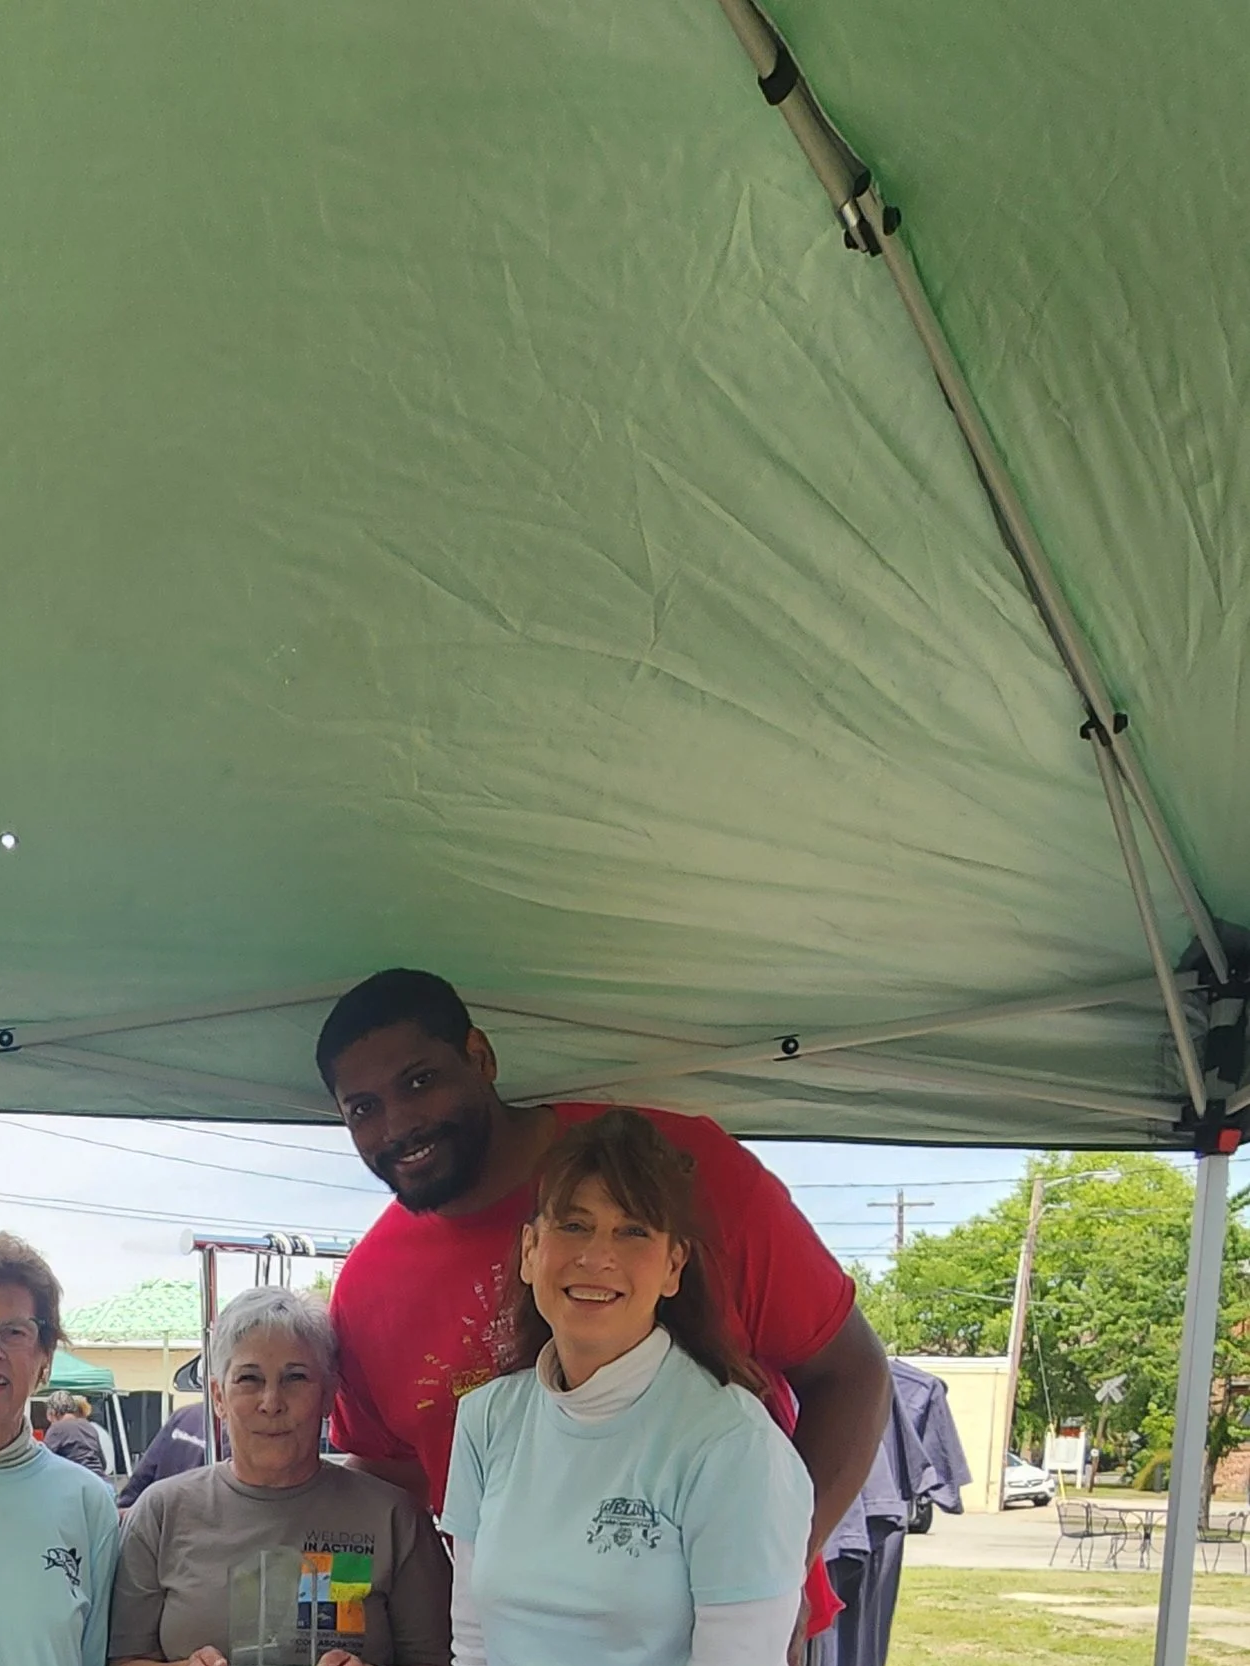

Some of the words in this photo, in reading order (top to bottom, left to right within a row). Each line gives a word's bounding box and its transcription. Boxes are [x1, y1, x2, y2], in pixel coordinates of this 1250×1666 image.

[306, 1530, 375, 1544] WELDON
[303, 1541, 318, 1552] IN
[321, 1542, 375, 1555] ACTION
